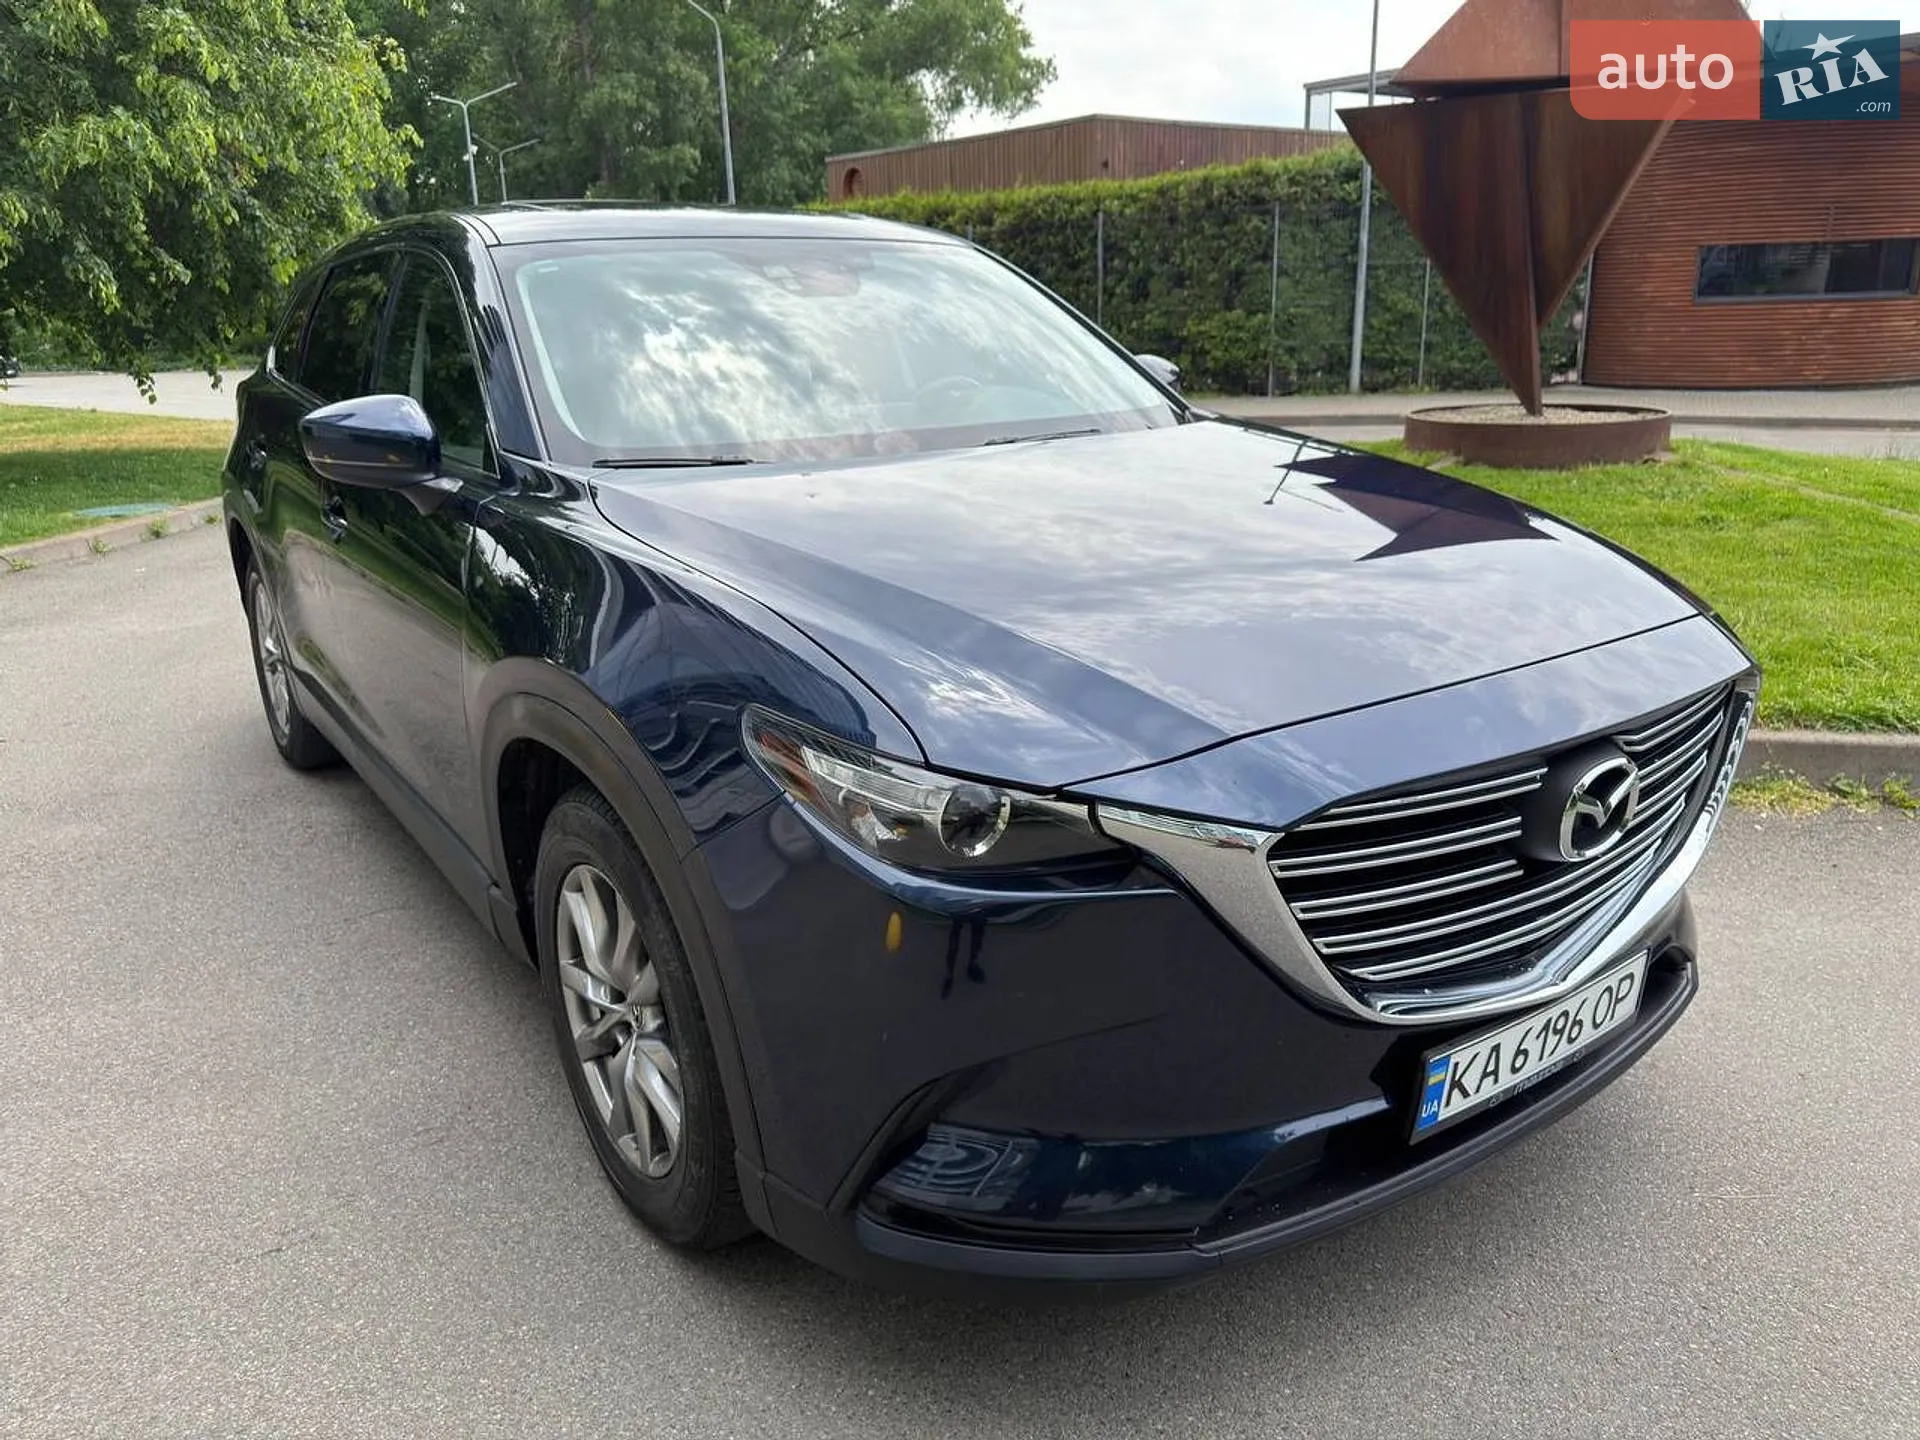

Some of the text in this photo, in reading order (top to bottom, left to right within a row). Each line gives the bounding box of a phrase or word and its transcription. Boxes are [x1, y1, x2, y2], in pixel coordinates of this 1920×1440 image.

[1444, 1042, 1502, 1107] KA
[1510, 998, 1588, 1075] 6196
[1592, 971, 1635, 1030] OP
[1422, 1102, 1439, 1117] UA
